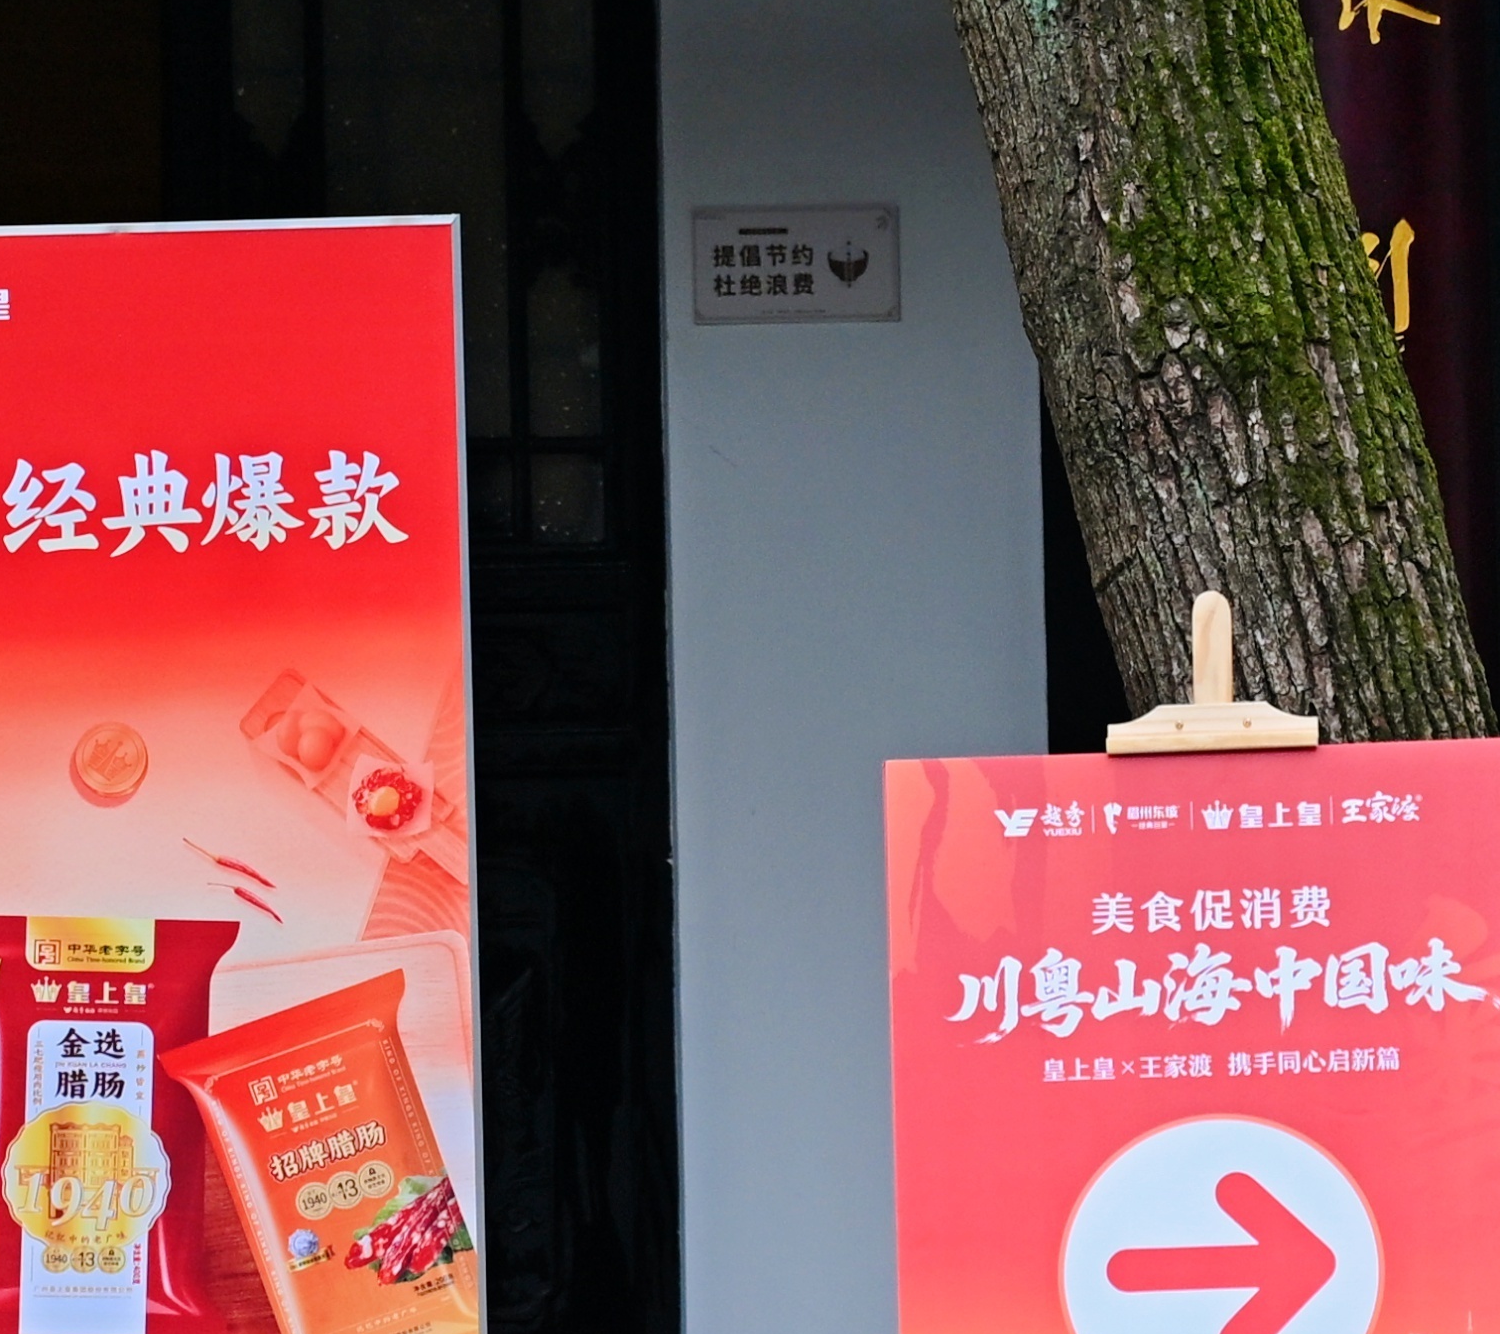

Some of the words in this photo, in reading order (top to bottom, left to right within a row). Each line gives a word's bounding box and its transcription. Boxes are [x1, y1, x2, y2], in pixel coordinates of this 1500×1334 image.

[713, 244, 814, 268] 提倡节约
[713, 273, 815, 297] 杜绝浪费
[1040, 800, 1085, 828] 越秀
[1238, 801, 1322, 829] 皇上皇
[1341, 790, 1421, 824] 王家渡
[1092, 884, 1332, 935] 美食促消费
[68, 943, 145, 957] 中华老字号
[67, 980, 147, 1005] 皇上皇
[56, 1027, 126, 1059] 金选
[277, 1054, 342, 1084] 中华老字号
[1227, 1046, 1399, 1077] 携手同心启新篇
[55, 1069, 126, 1099] 腊肠
[287, 1083, 357, 1123] 皇上皇
[270, 1120, 386, 1181] 招牌腊肠
[17, 1172, 159, 1231] 1940
[302, 1191, 328, 1211] 1940
[45, 1252, 69, 1264] 1940
